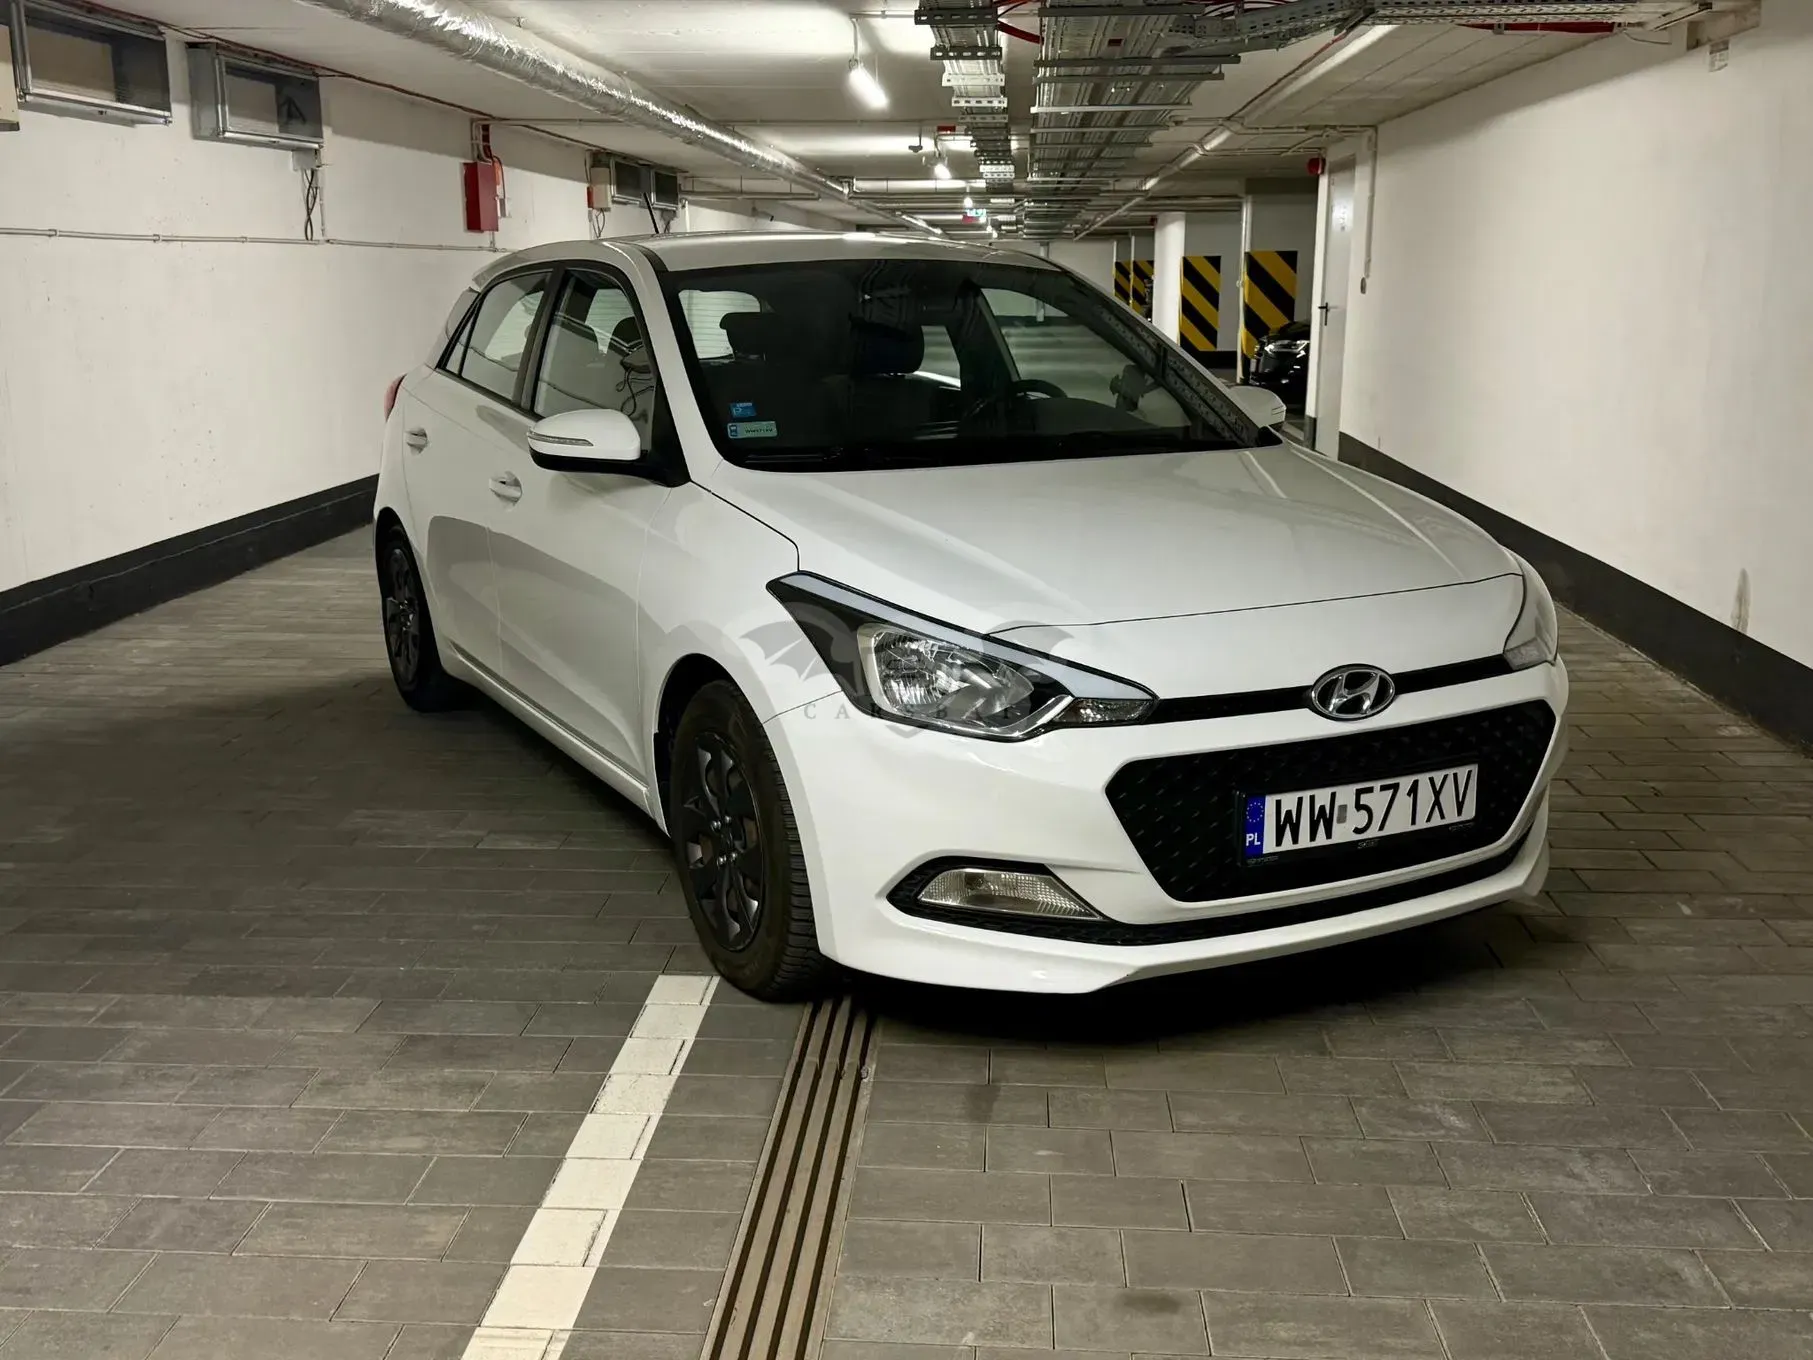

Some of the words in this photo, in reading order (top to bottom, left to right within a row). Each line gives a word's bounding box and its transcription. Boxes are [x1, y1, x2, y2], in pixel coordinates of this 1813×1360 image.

[1275, 791, 1337, 847] WW
[1352, 769, 1473, 835] 571XV
[1245, 832, 1261, 847] PL
